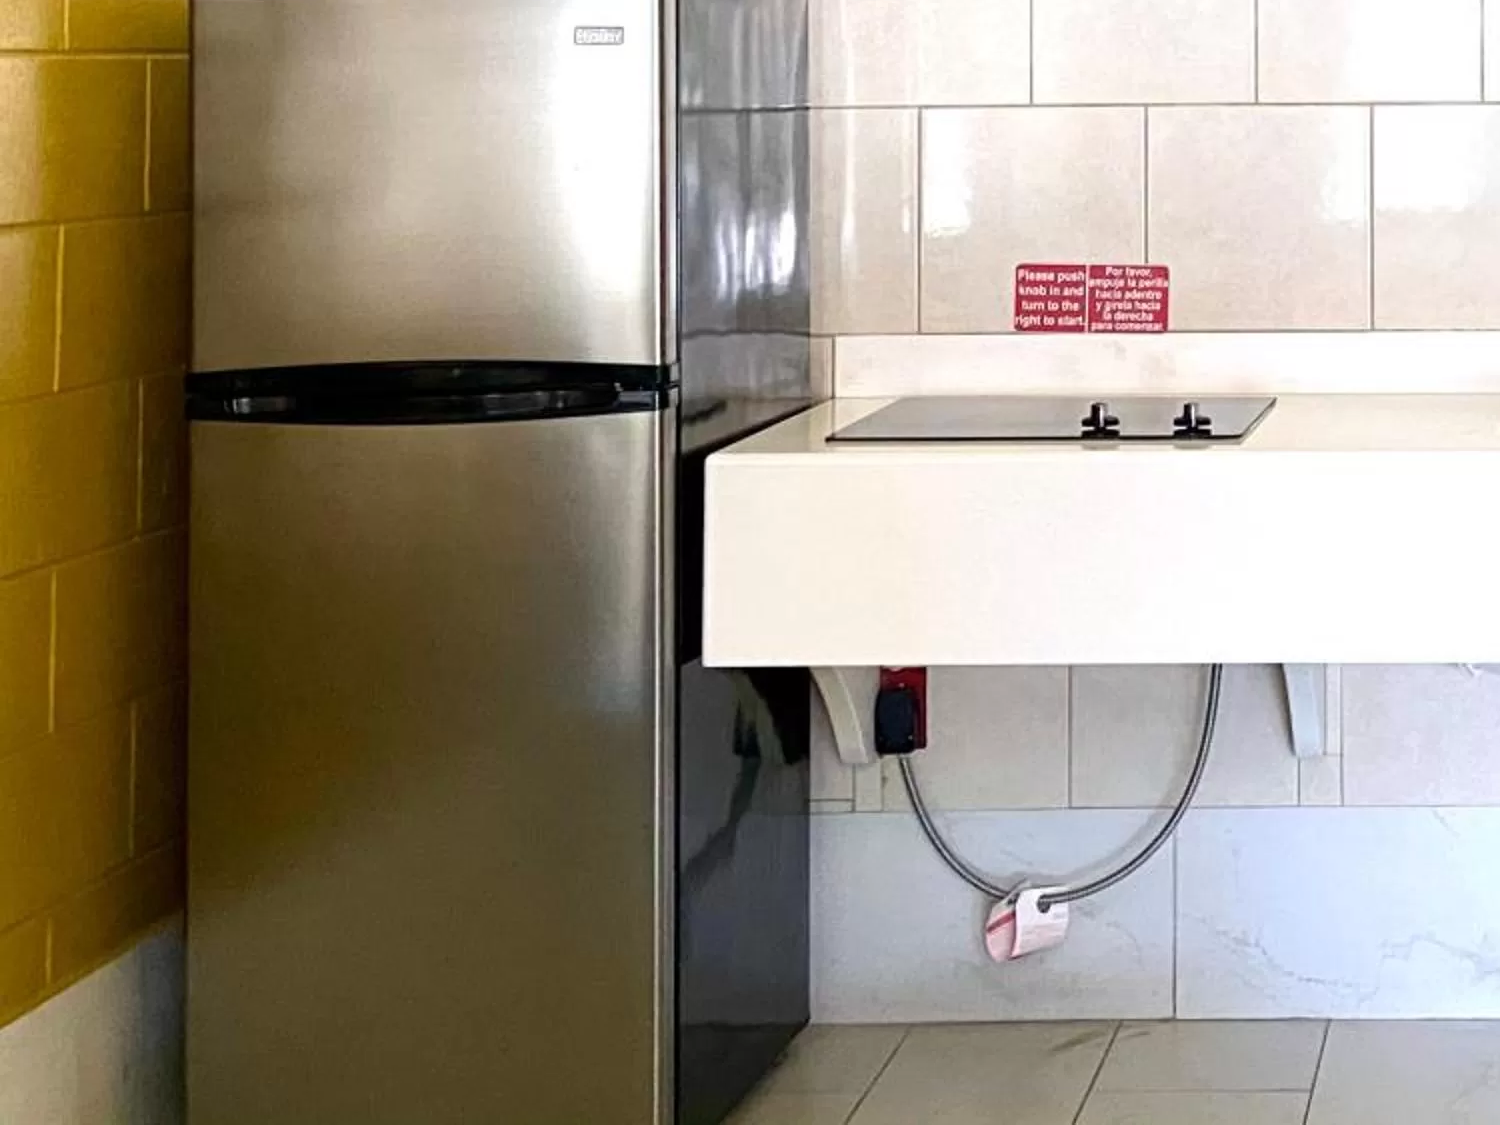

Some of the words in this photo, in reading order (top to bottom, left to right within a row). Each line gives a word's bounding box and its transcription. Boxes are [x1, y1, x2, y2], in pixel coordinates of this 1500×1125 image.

[1018, 268, 1054, 281] Please
[1057, 271, 1084, 284] push
[1105, 266, 1124, 276] Por
[1089, 278, 1125, 290] empuje
[1127, 278, 1137, 288] la
[1138, 278, 1169, 289] perilla
[1018, 284, 1046, 296] knob
[1050, 285, 1061, 296] in
[1063, 285, 1084, 296] and
[1124, 289, 1163, 300] adentro
[1021, 300, 1045, 311] turn
[1047, 300, 1059, 311] to
[1062, 300, 1080, 311] the
[1095, 301, 1103, 313] y
[1134, 300, 1161, 311] hacia
[1015, 315, 1041, 328] right
[1043, 315, 1055, 326] to
[1103, 311, 1112, 321] la
[1114, 311, 1154, 322] derecha
[1091, 322, 1113, 332] para
